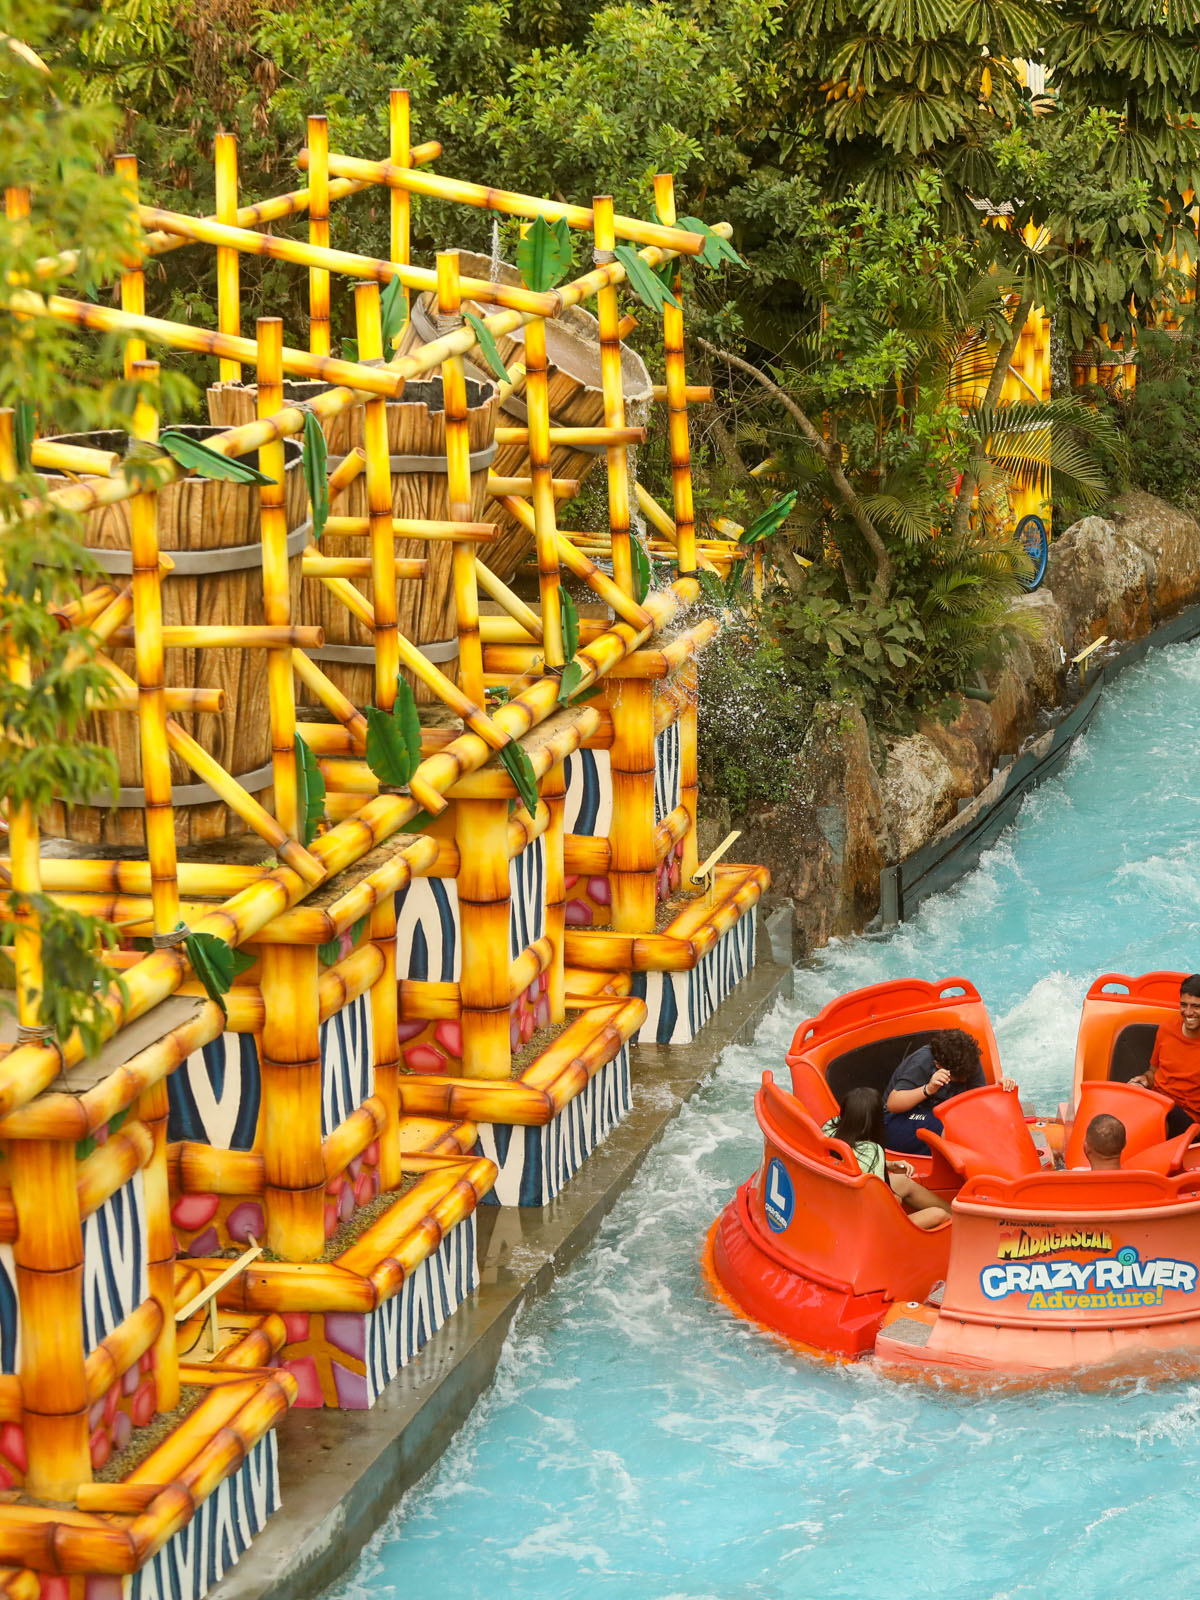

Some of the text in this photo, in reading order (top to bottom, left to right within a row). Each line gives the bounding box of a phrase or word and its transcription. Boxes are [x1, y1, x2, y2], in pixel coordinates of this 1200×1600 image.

[770, 1164, 786, 1211] L
[997, 1229, 1113, 1259] MADAGASCAR
[982, 1262, 1094, 1298] CRAZY
[1029, 1285, 1164, 1308] Adventure!
